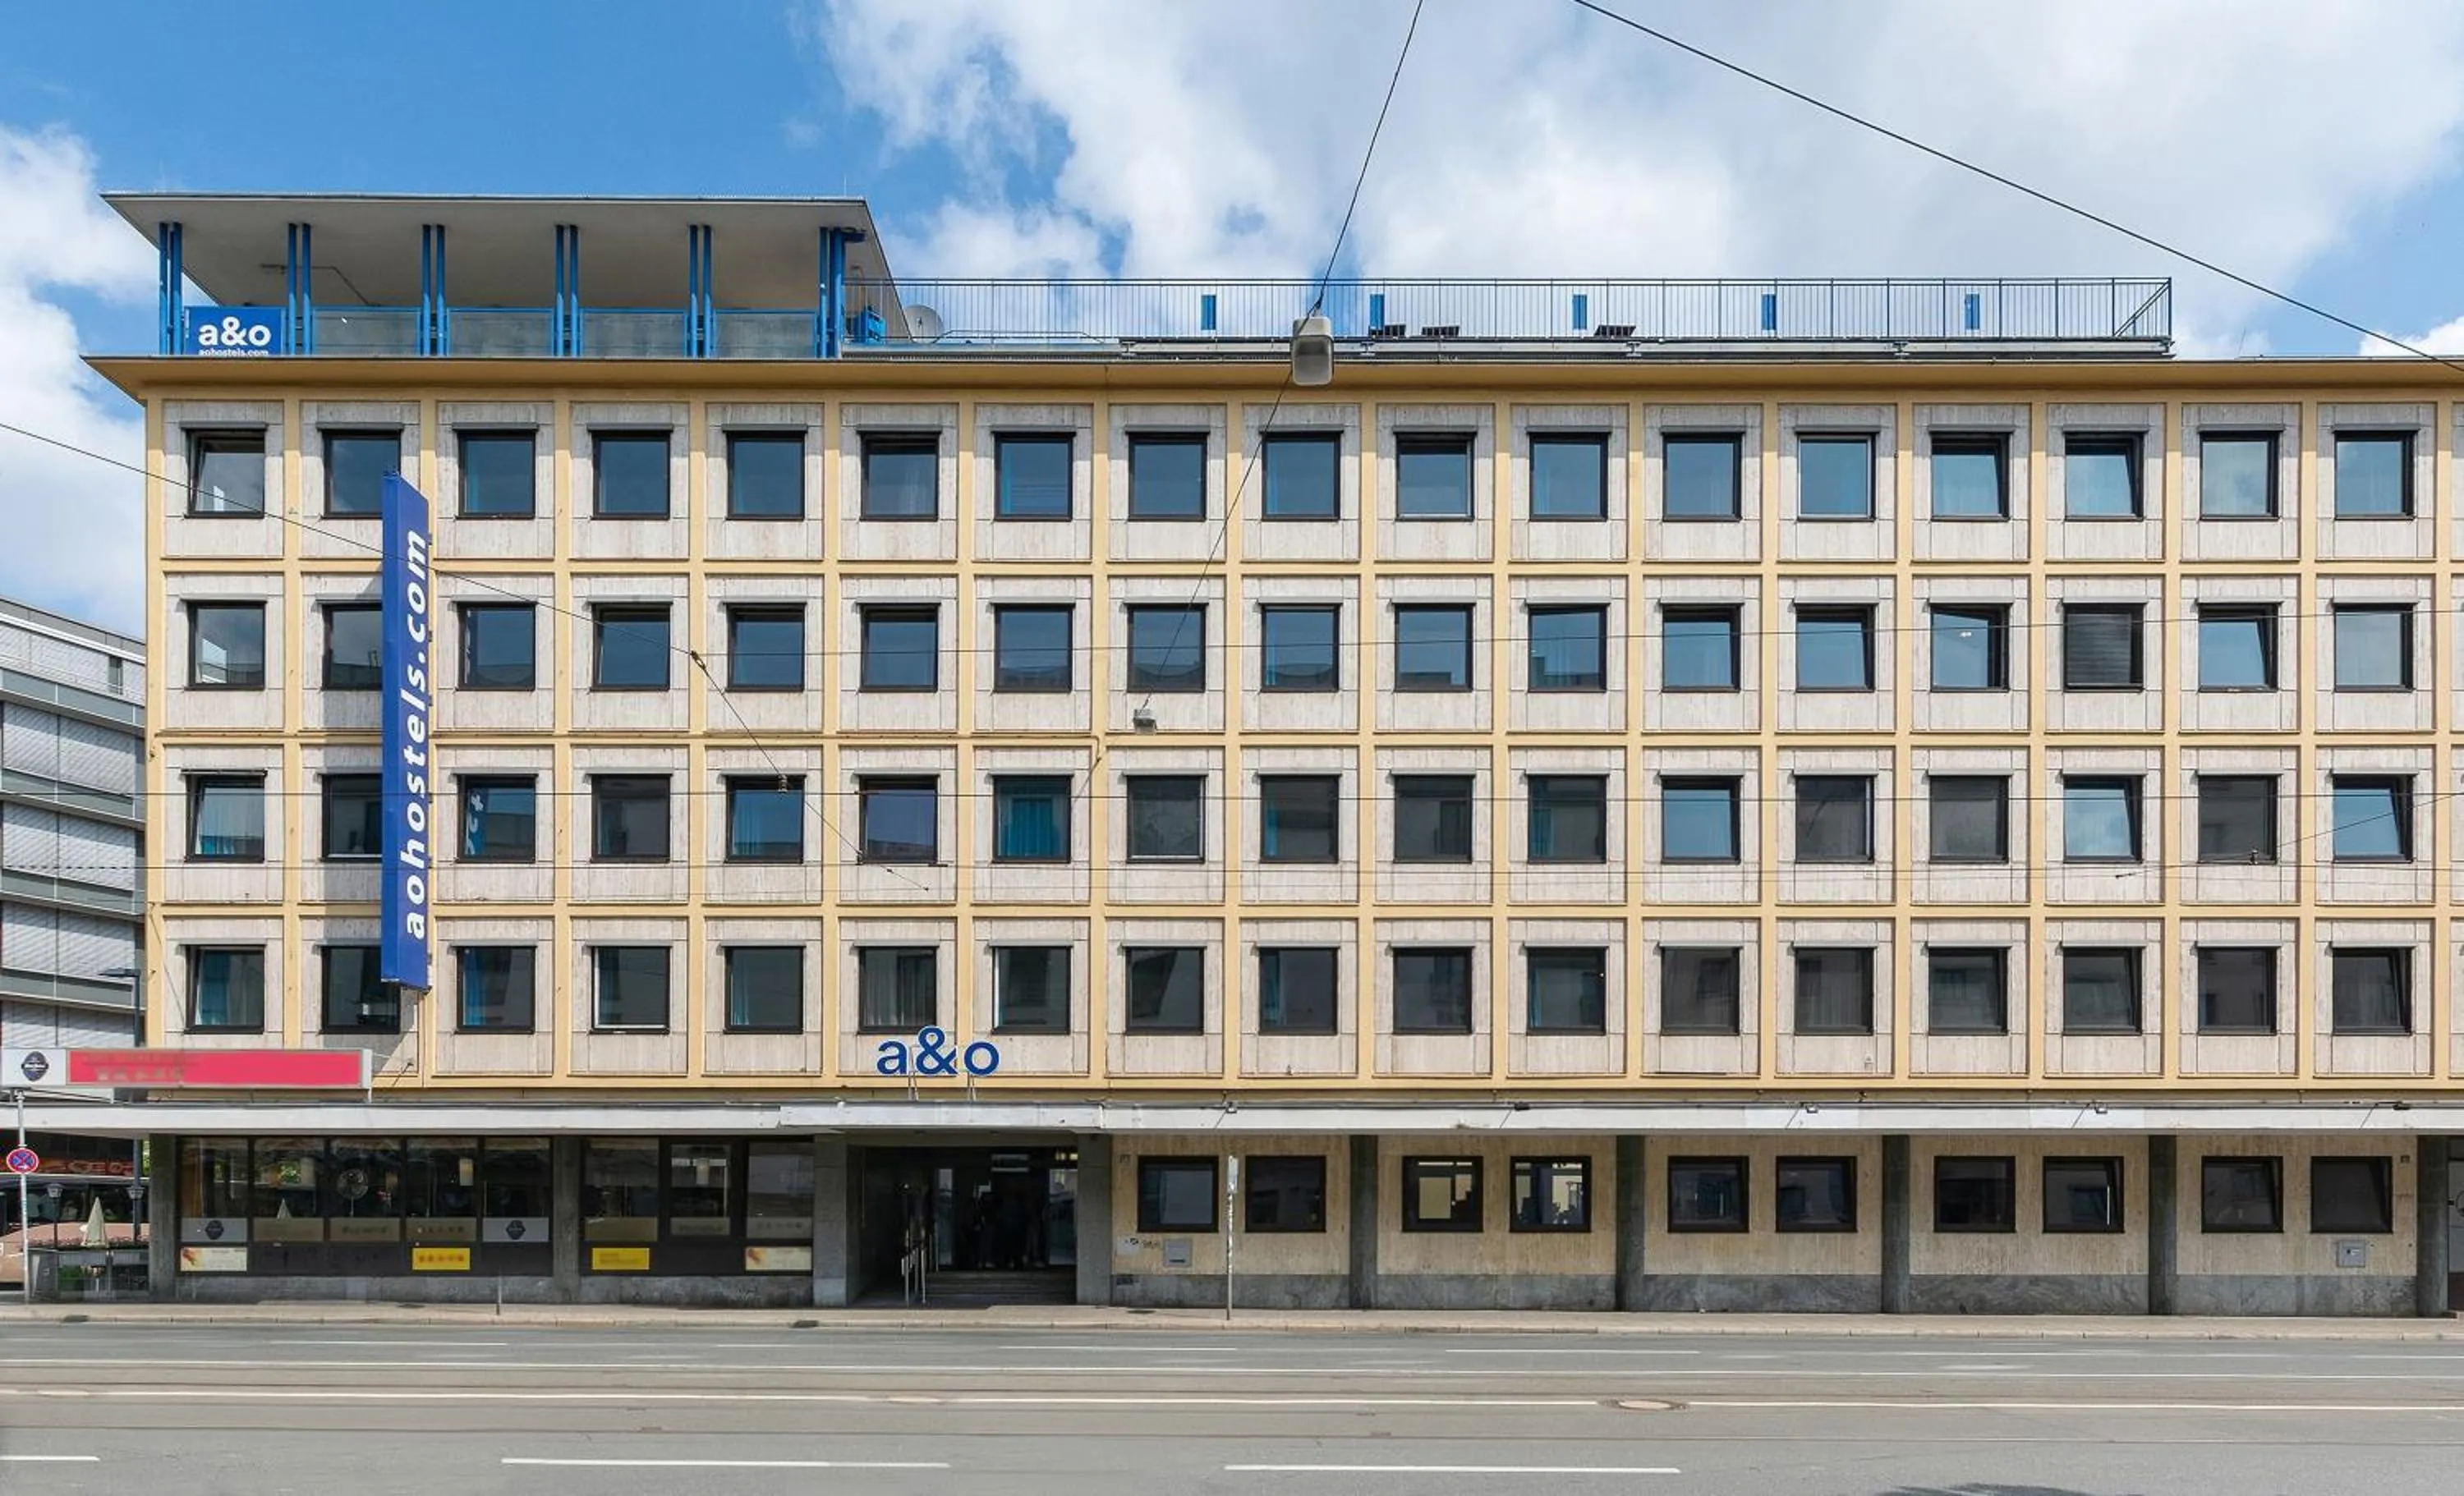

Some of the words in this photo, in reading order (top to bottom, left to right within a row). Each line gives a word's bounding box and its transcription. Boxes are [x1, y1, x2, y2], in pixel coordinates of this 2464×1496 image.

[199, 316, 271, 346] a&o
[198, 347, 269, 356] aohostels.com
[400, 530, 426, 939] aohostels.com
[876, 1025, 1000, 1076] a&o
